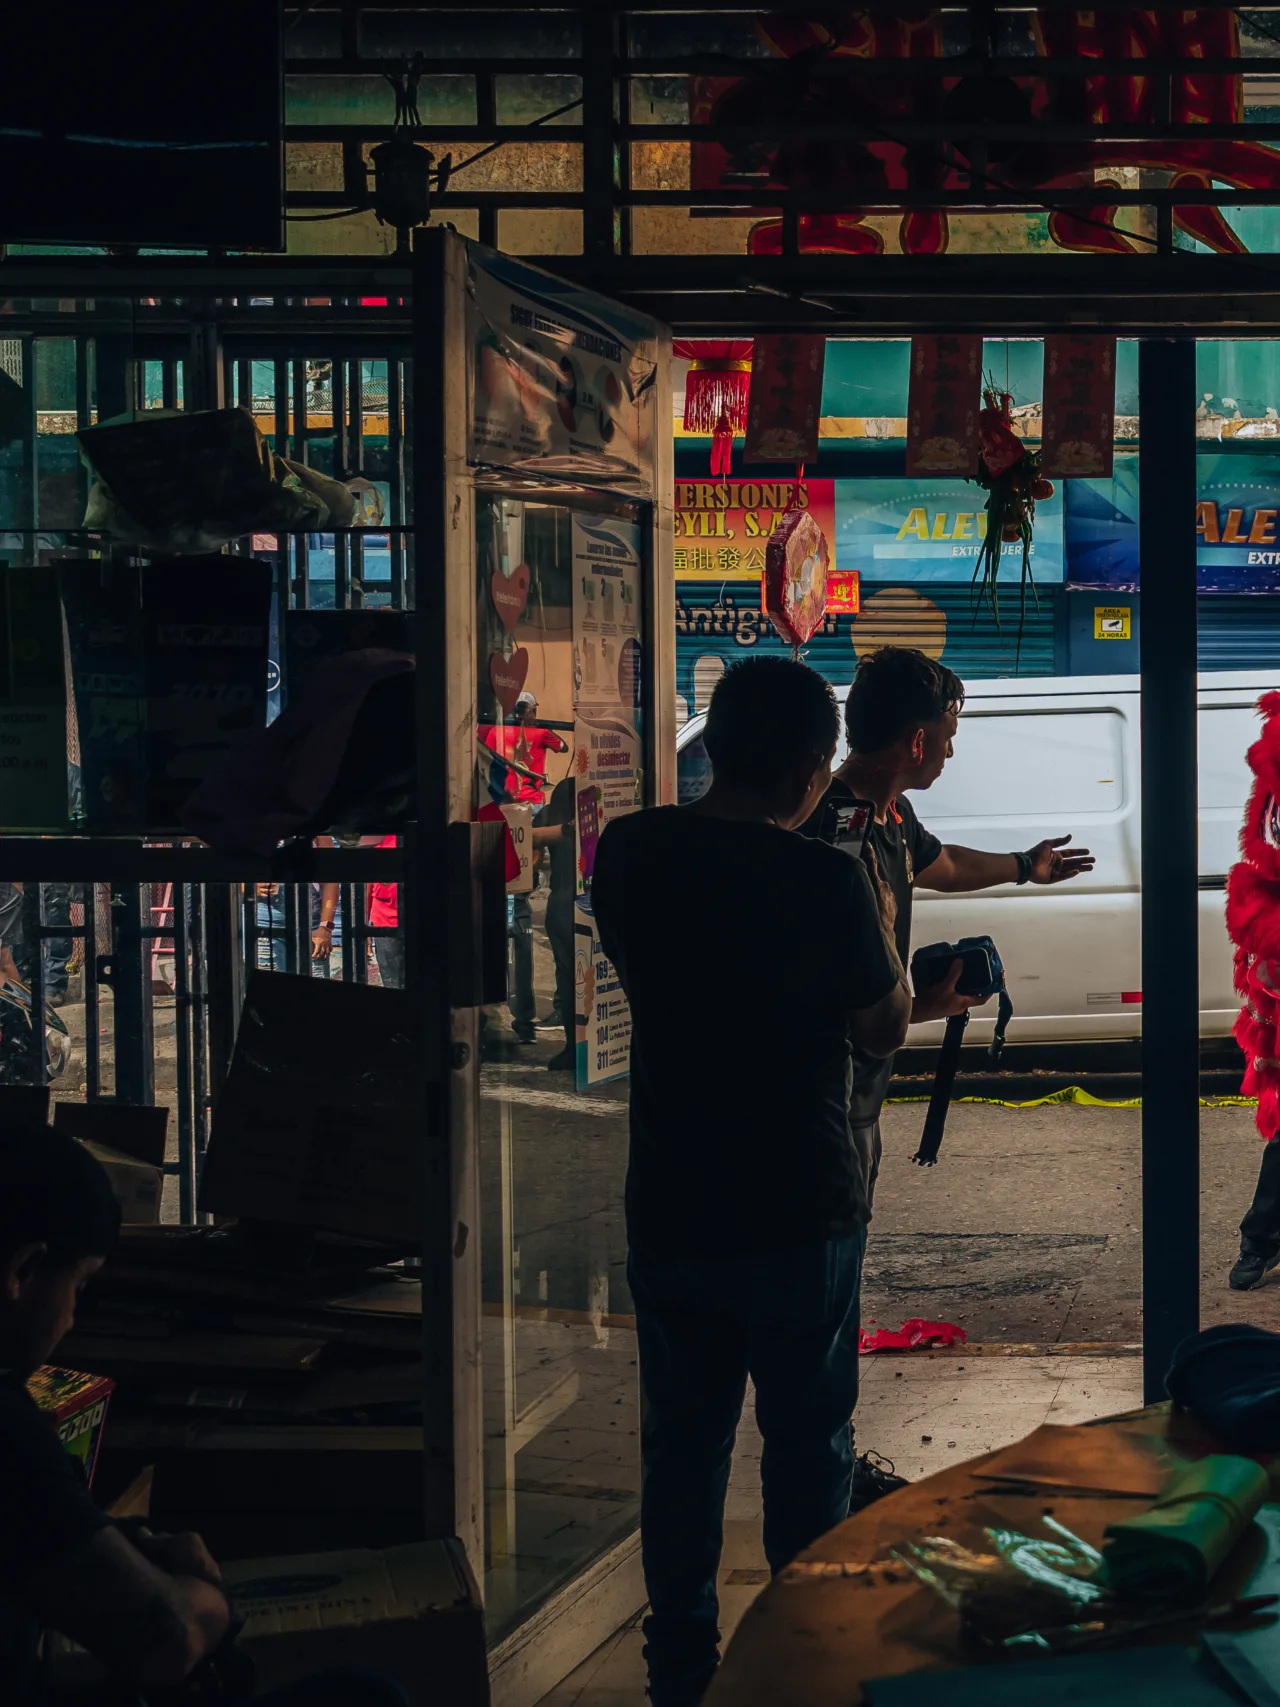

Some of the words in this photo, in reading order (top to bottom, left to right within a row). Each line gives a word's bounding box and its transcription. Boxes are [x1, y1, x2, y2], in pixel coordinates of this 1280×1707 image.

[674, 484, 809, 508] ERSIONES
[596, 1001, 608, 1022] 911
[596, 1025, 608, 1046] 104
[597, 1049, 608, 1070] 311
